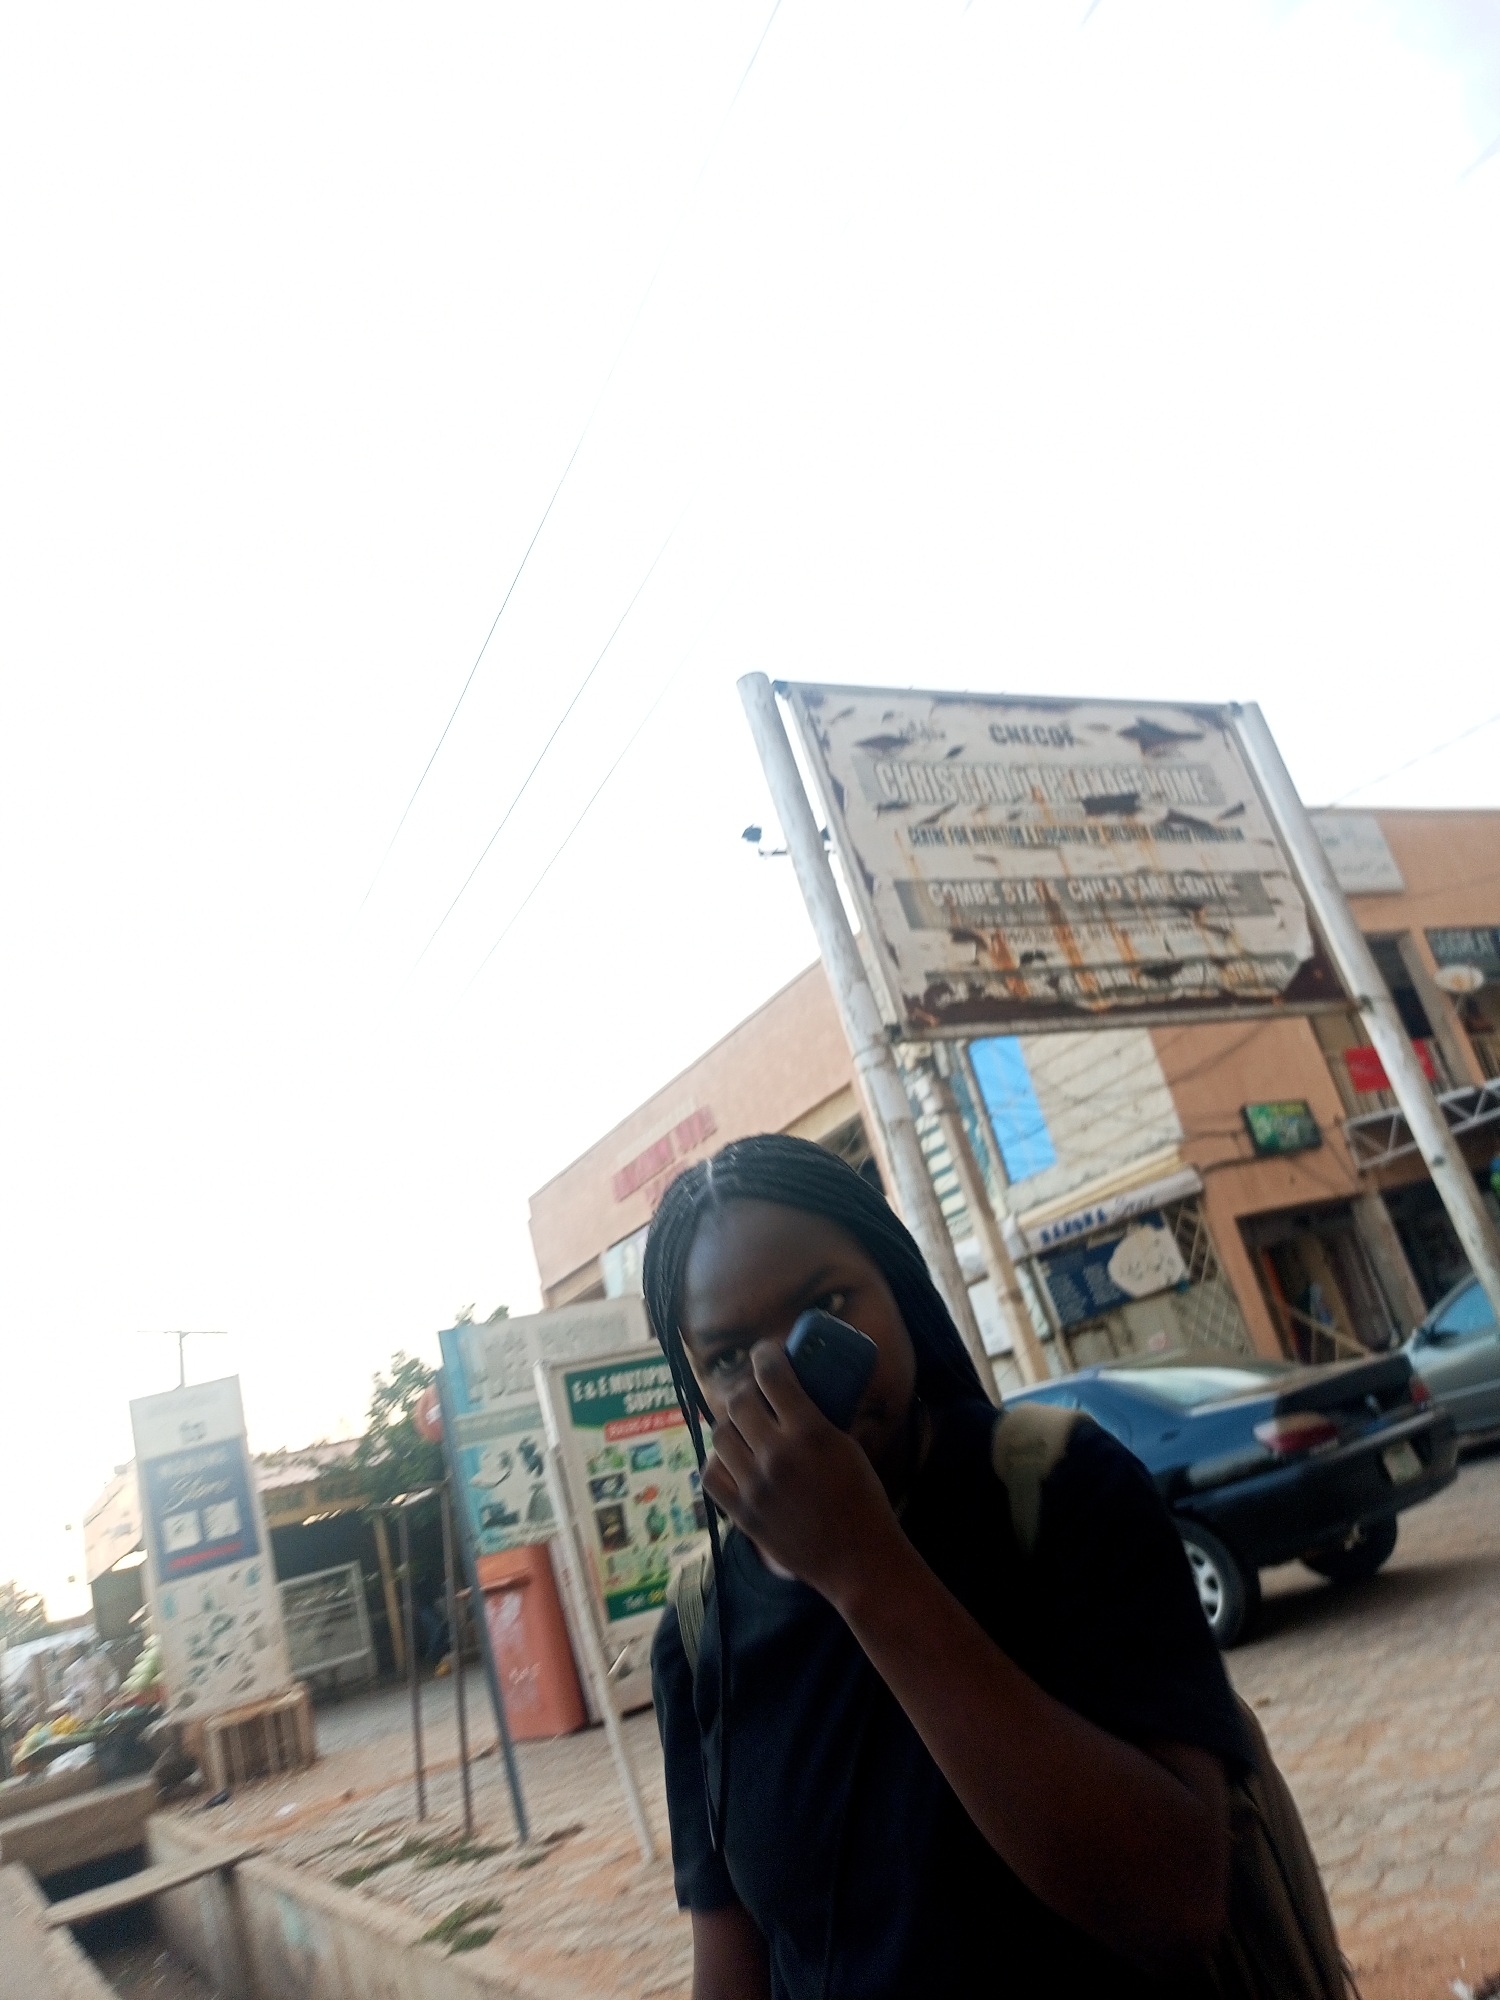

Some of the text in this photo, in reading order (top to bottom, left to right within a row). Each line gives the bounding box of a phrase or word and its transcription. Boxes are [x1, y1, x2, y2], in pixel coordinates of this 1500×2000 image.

[875, 762, 1008, 803] CHRISTIAN
[1152, 768, 1211, 803] HOME
[928, 882, 1001, 907] GOMBE
[1067, 878, 1123, 901] CHILD
